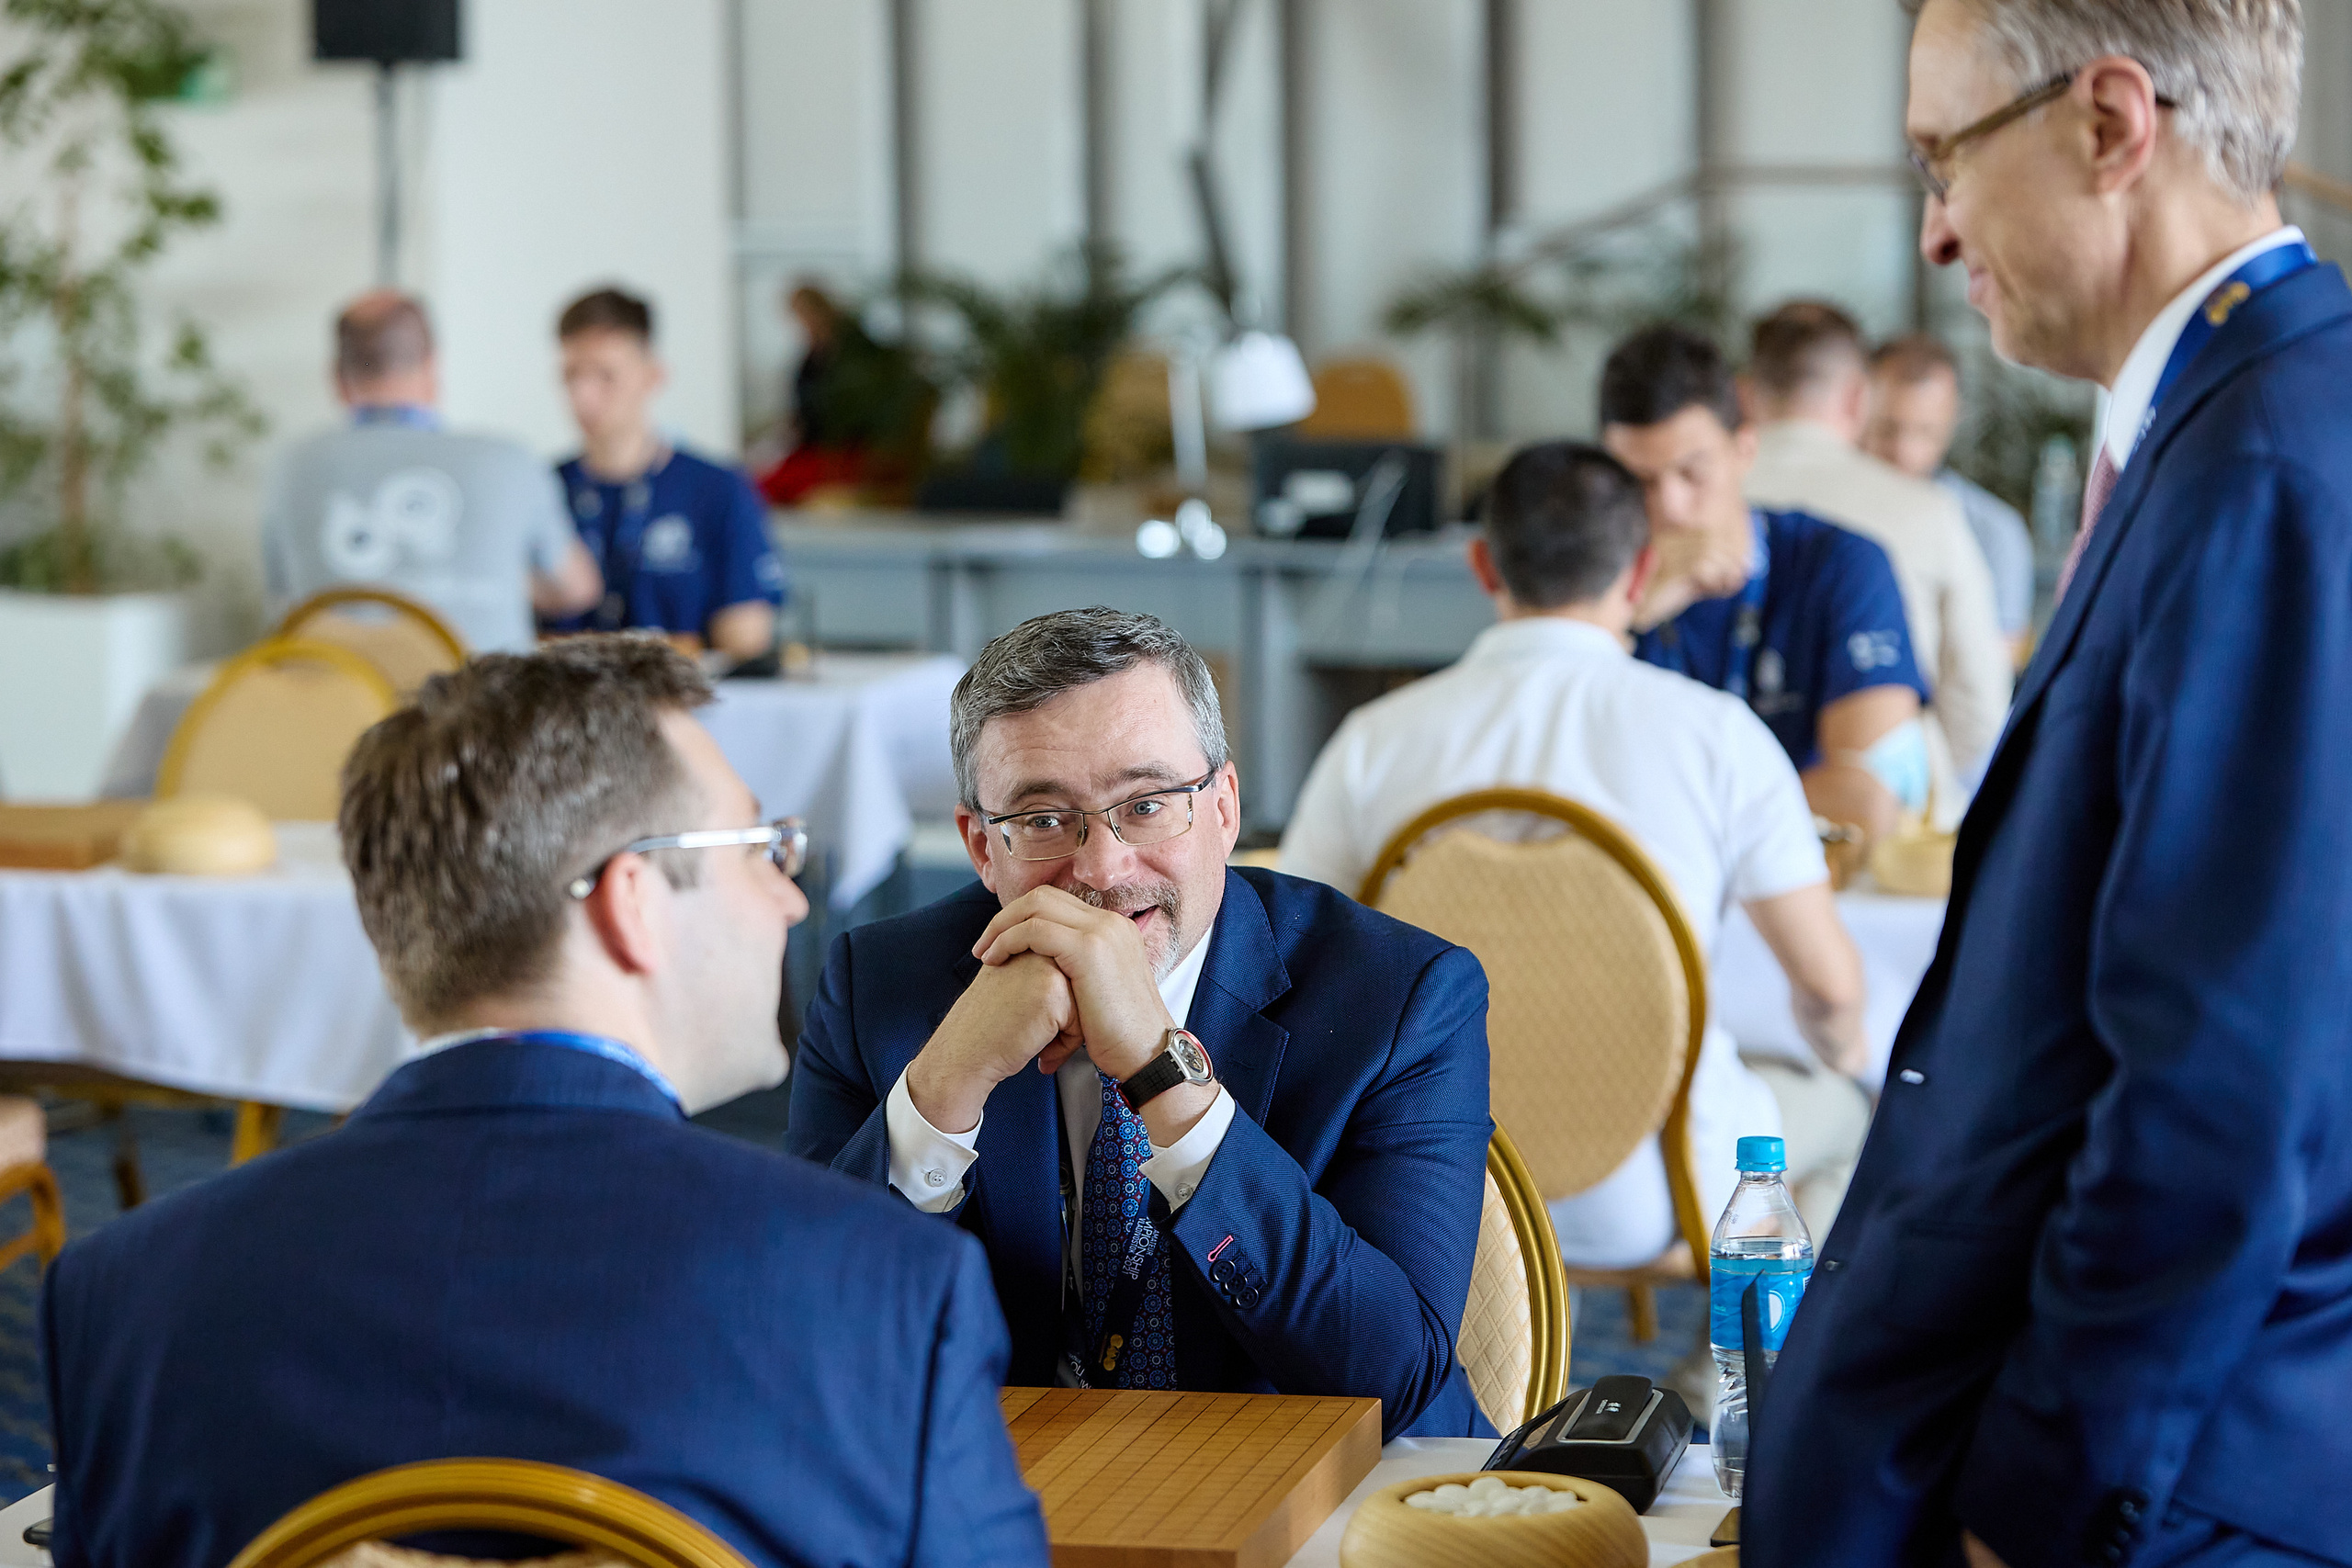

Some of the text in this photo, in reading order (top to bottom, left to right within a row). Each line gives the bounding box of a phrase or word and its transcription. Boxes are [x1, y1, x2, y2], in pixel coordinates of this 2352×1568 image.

[1122, 1218, 1147, 1275] VLADIVOSTOK 2021
[1146, 1229, 1159, 1256] AMATEUR
